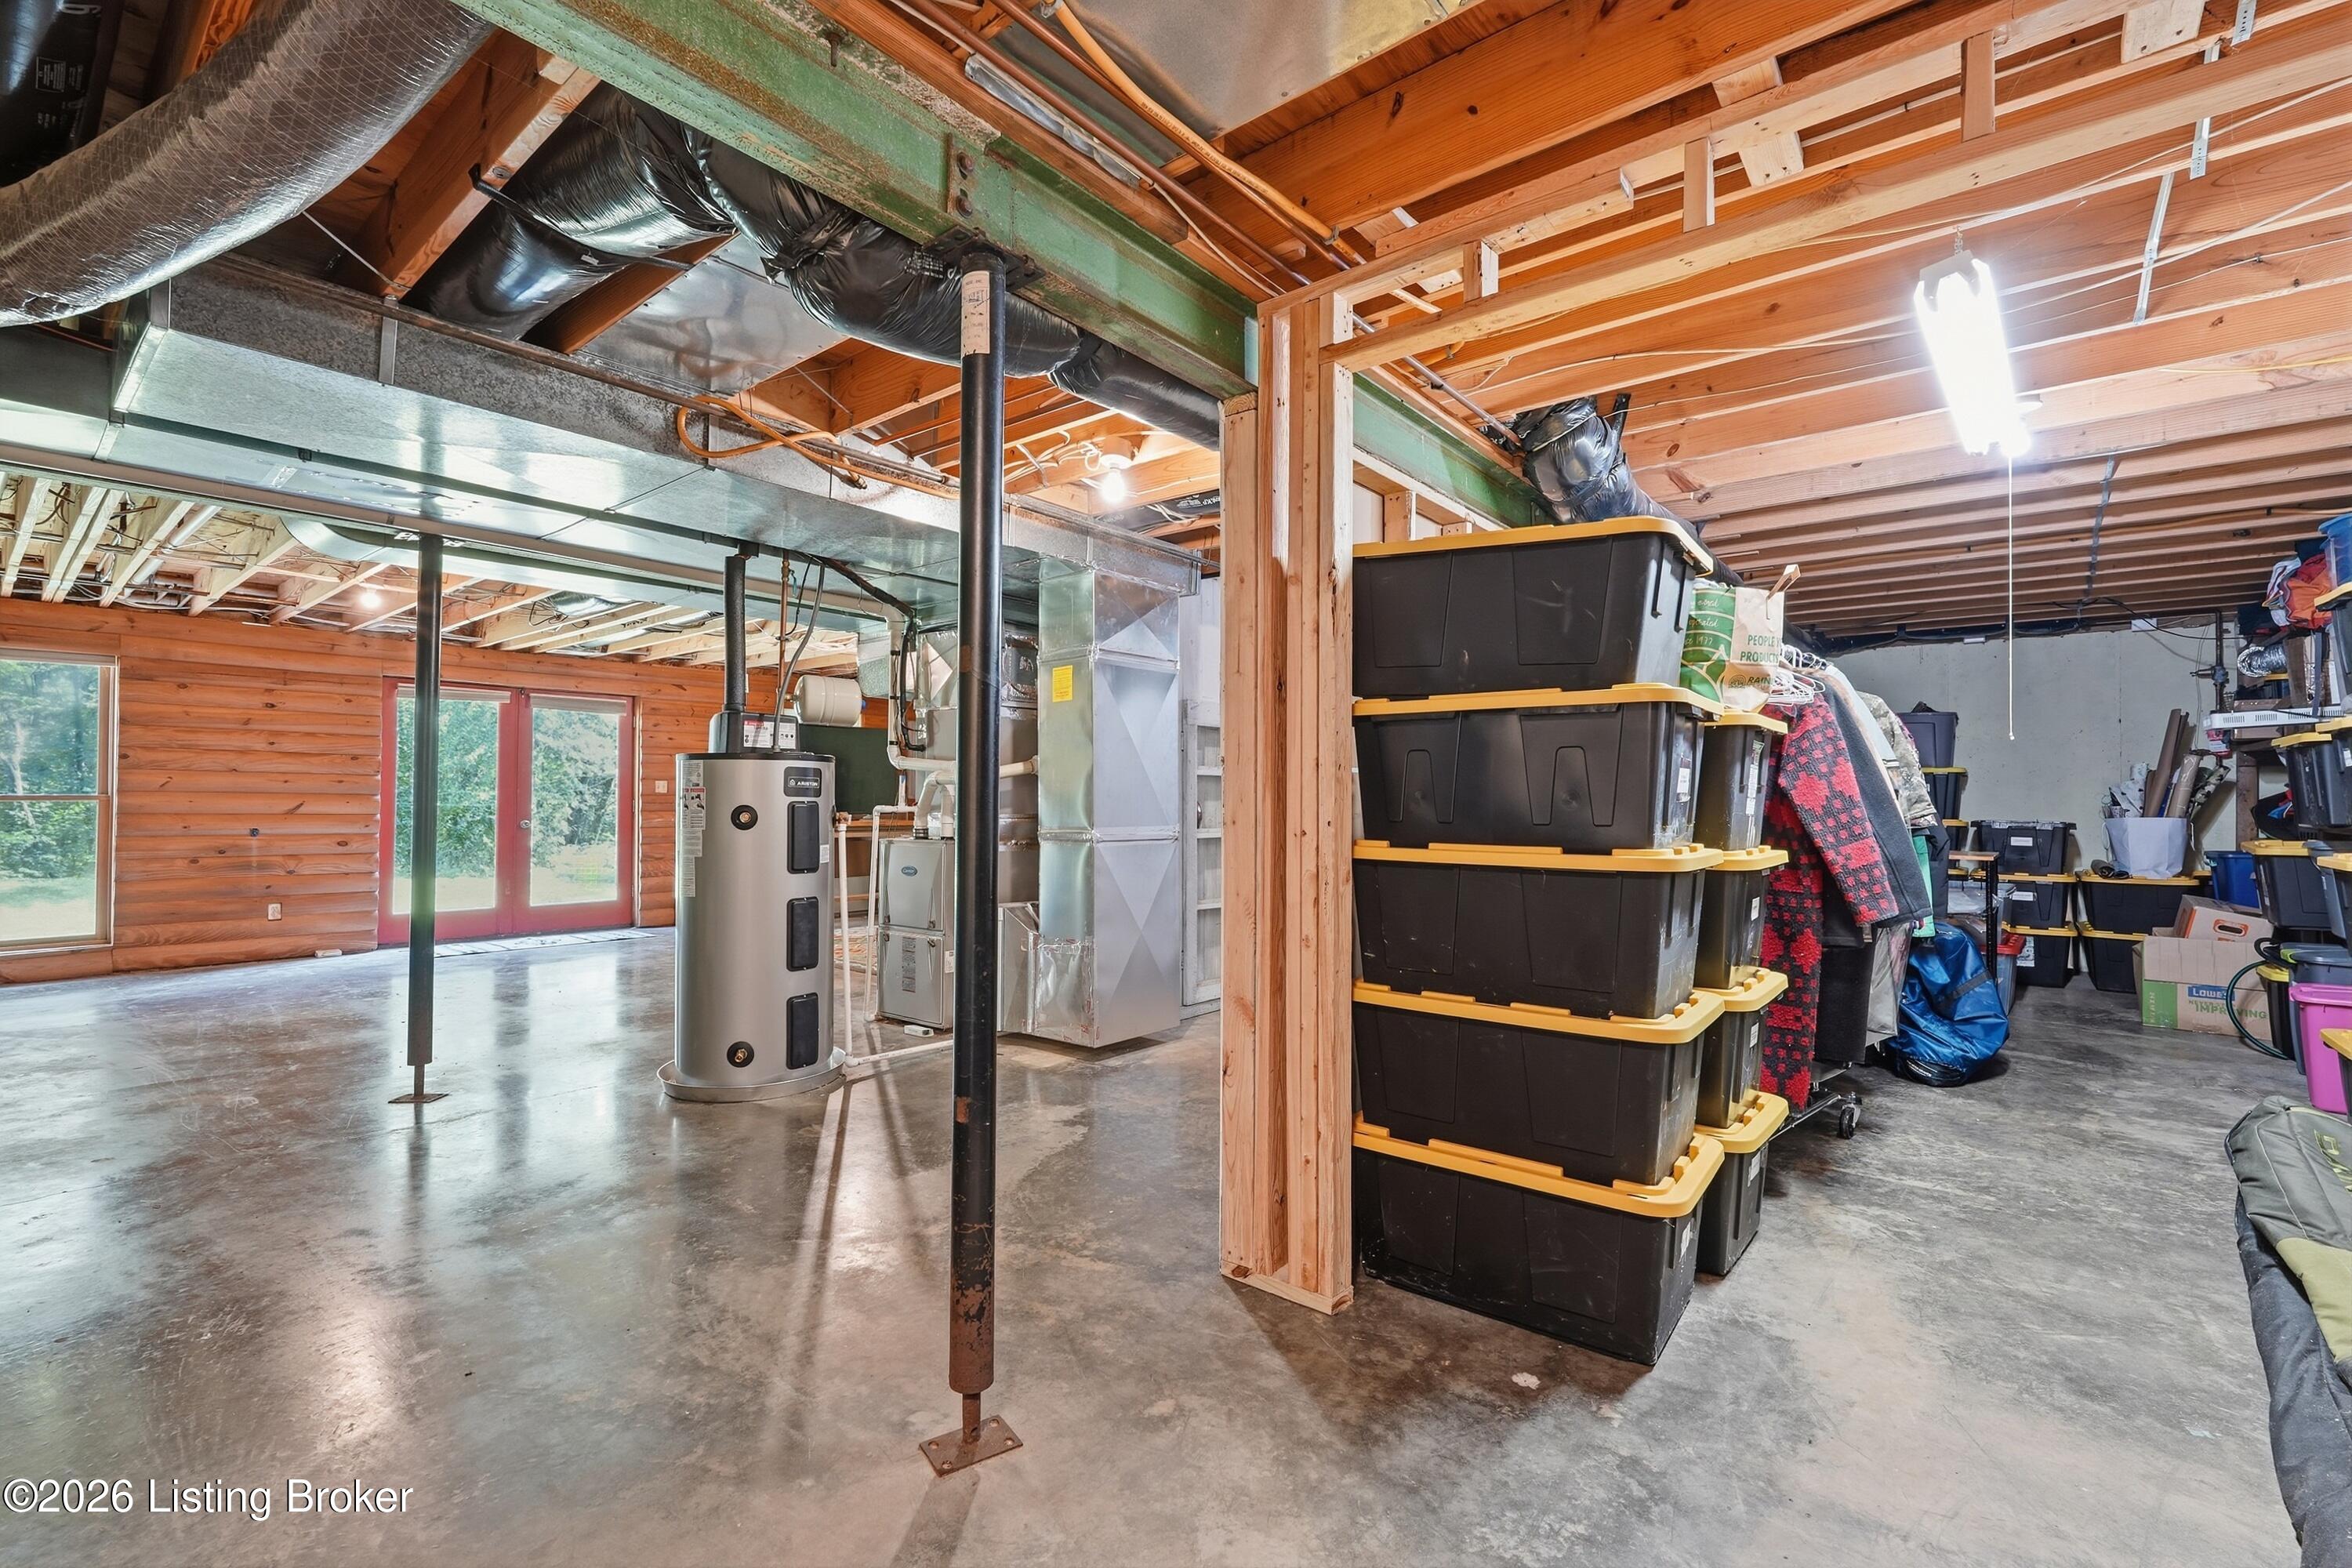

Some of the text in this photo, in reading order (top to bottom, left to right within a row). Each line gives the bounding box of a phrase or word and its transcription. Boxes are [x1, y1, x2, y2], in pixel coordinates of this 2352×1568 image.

[1747, 634, 1775, 647] PEOPLE
[1740, 651, 1780, 664] PRODUCTS
[1747, 676, 1773, 686] RAIN
[2195, 1003, 2267, 1018] IMPRVING
